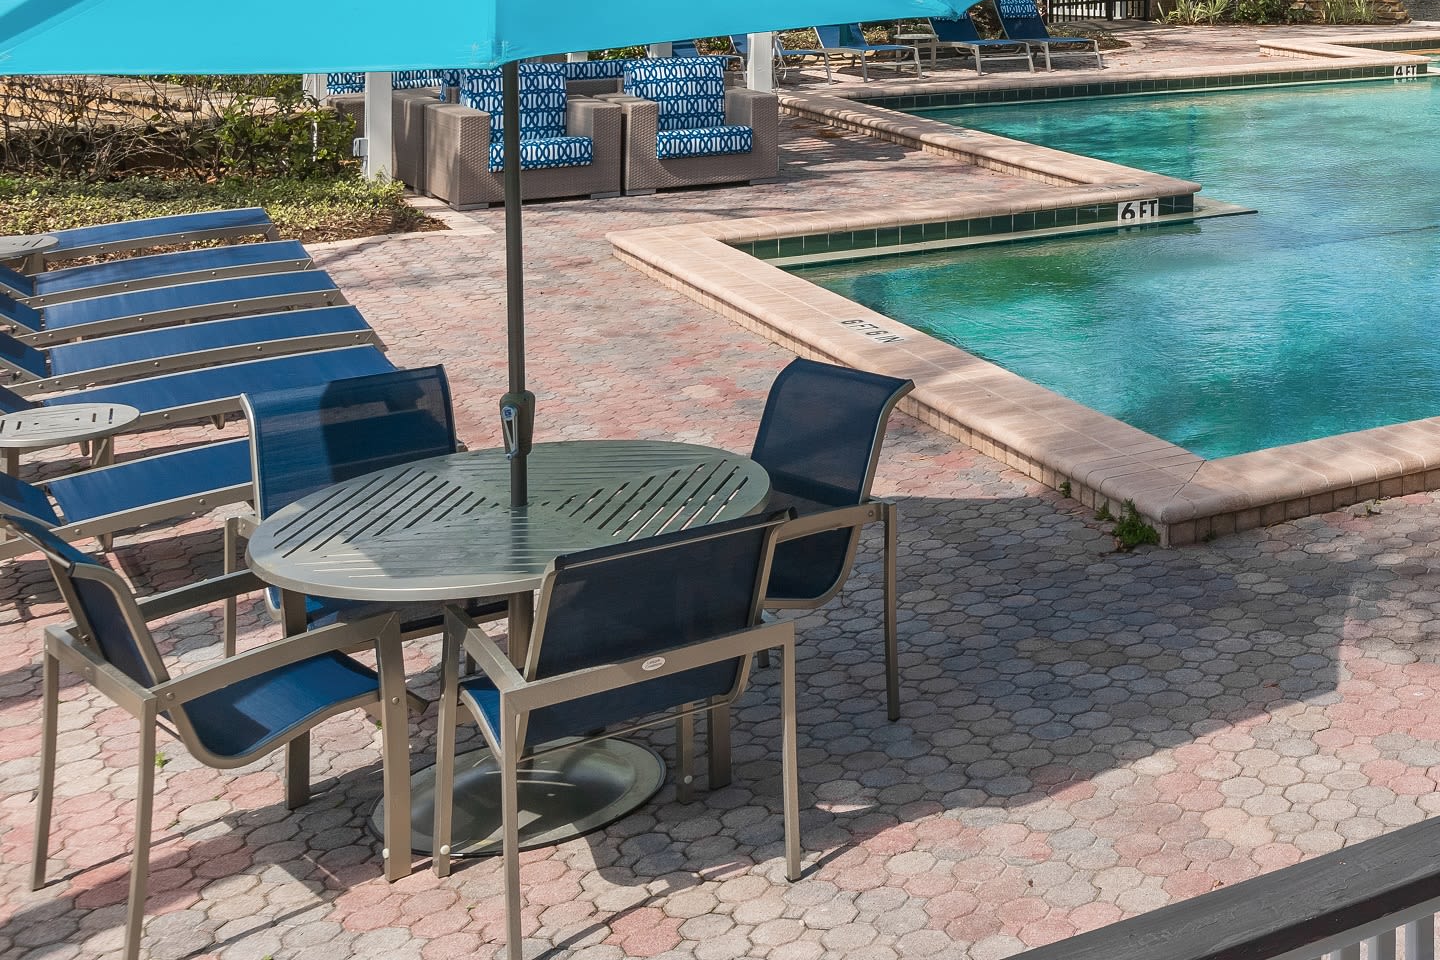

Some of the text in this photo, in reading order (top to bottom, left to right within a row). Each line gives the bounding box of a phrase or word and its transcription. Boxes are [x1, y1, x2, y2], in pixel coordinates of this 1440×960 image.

[1396, 65, 1416, 76] 4 FT
[1121, 199, 1158, 220] 6 FT
